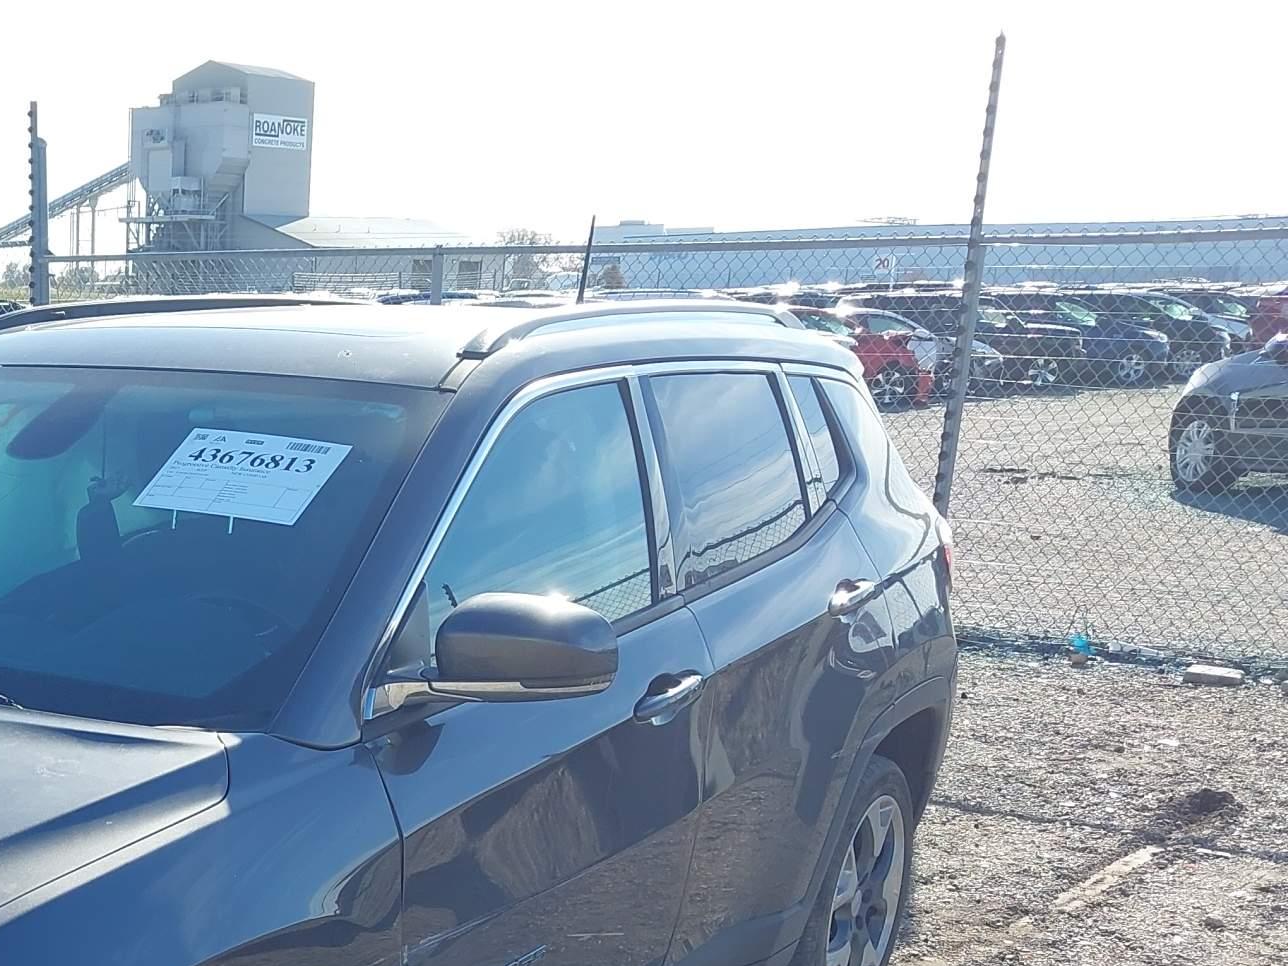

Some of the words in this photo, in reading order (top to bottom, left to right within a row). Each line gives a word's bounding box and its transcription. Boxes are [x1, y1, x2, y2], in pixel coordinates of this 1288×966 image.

[254, 119, 306, 138] ROANOKE
[254, 137, 280, 147] CONCRETE
[279, 141, 305, 149] PRODUCTS
[874, 257, 890, 269] 20
[188, 446, 316, 474] 43676813
